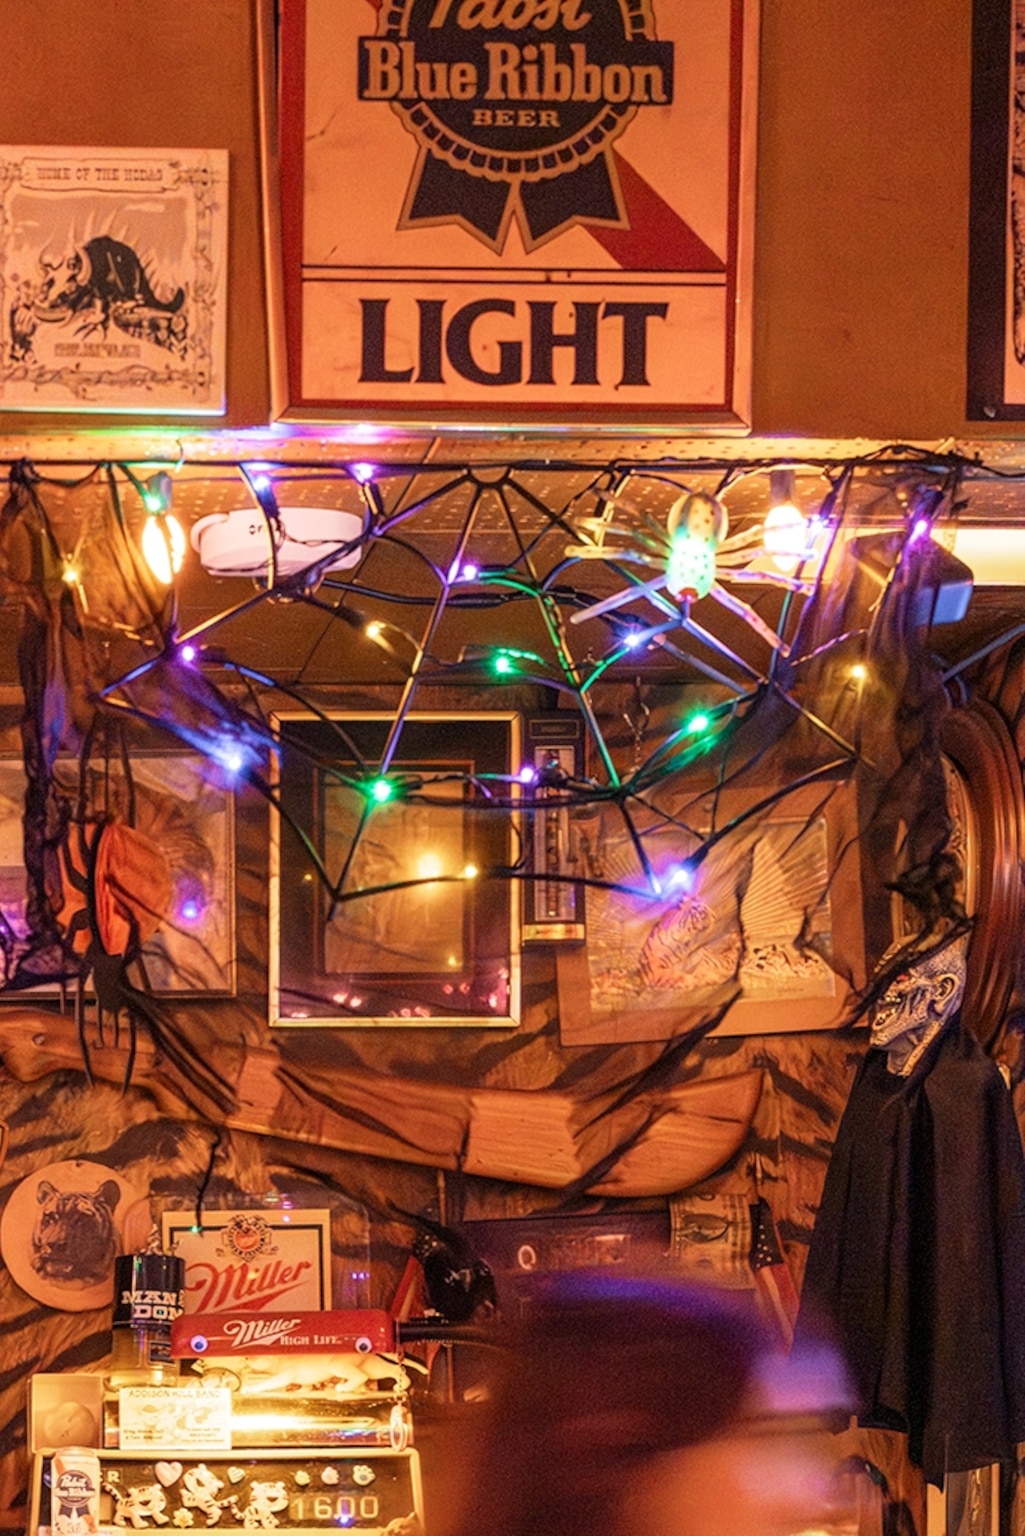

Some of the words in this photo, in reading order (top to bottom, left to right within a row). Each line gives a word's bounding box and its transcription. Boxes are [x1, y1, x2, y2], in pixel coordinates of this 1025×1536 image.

[362, 41, 478, 100] Blue
[484, 42, 668, 103] Ribbon
[472, 108, 561, 128] BEER
[358, 298, 669, 388] LIGHT
[185, 1260, 313, 1314] Miller
[223, 1318, 302, 1349] Miller
[291, 1496, 379, 1520] 1600
